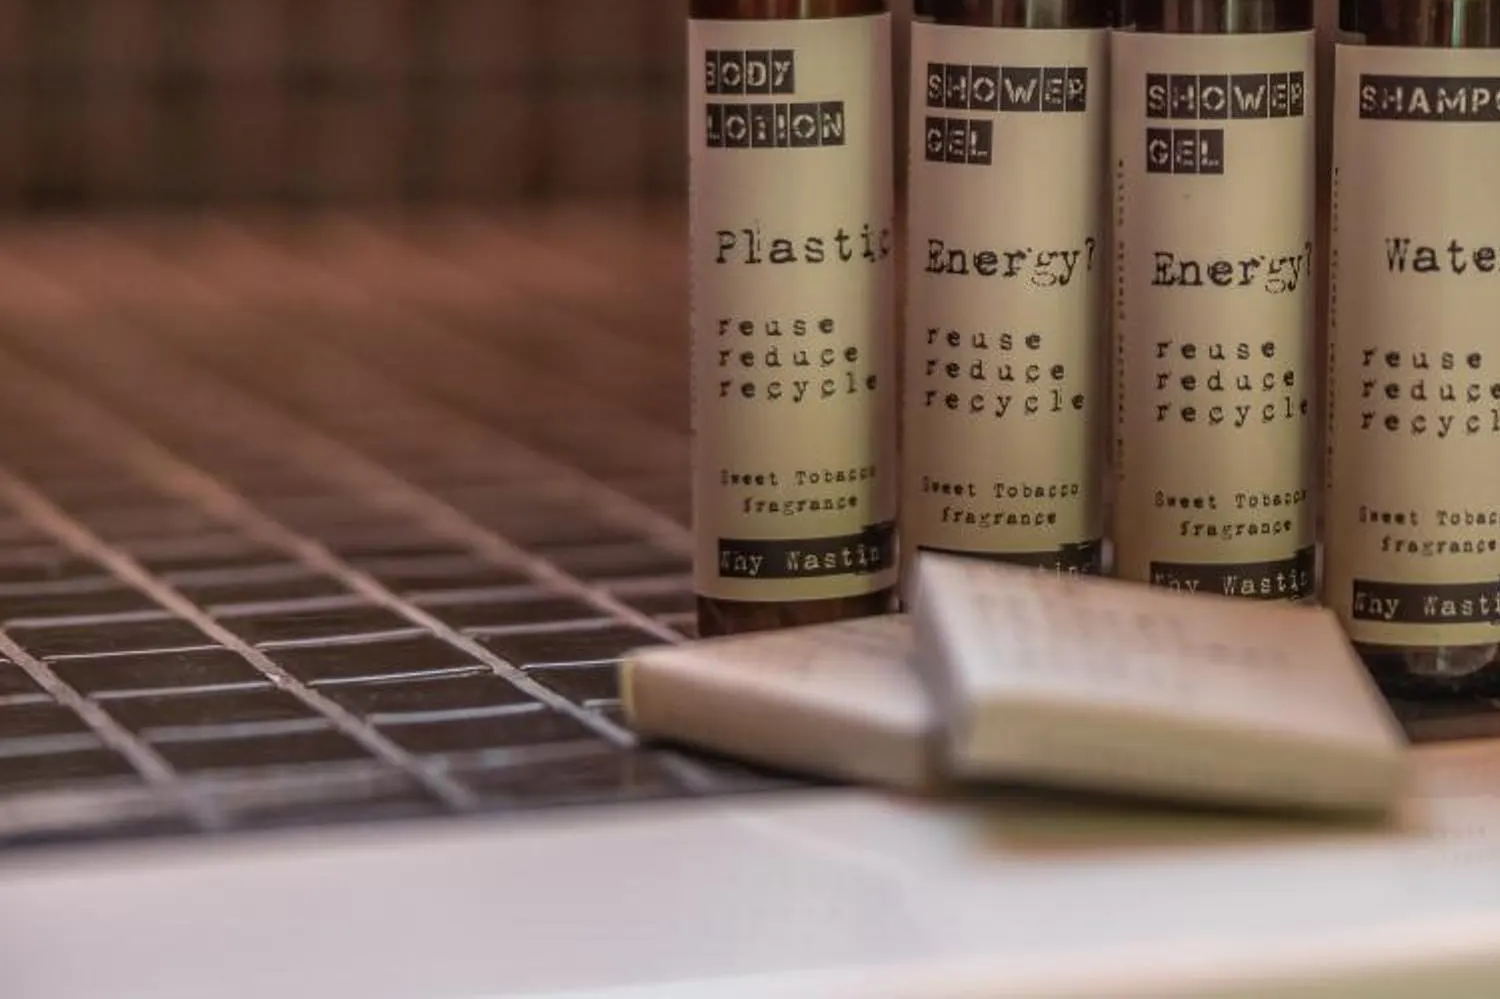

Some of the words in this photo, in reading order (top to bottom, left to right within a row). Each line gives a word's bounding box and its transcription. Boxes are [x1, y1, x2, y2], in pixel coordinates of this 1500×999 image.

[927, 72, 1087, 105] SHOWER
[926, 127, 989, 158] GEL
[1148, 138, 1220, 167] GEL
[718, 315, 836, 337] reuse
[926, 325, 1042, 350] reuse
[718, 344, 859, 368] reduce
[1155, 338, 1276, 360] reuse
[1360, 346, 1482, 370] reuse
[924, 356, 1065, 384] reduce
[1155, 367, 1296, 392] reduce
[718, 371, 878, 402] recycle
[924, 388, 1085, 417] recycle
[1155, 398, 1309, 428] recycle
[743, 496, 859, 516] fragrance
[1153, 489, 1217, 510] Sweet
[941, 507, 1057, 528] fragrance
[1179, 520, 1293, 541] fragrance
[1381, 535, 1498, 557] fragrance
